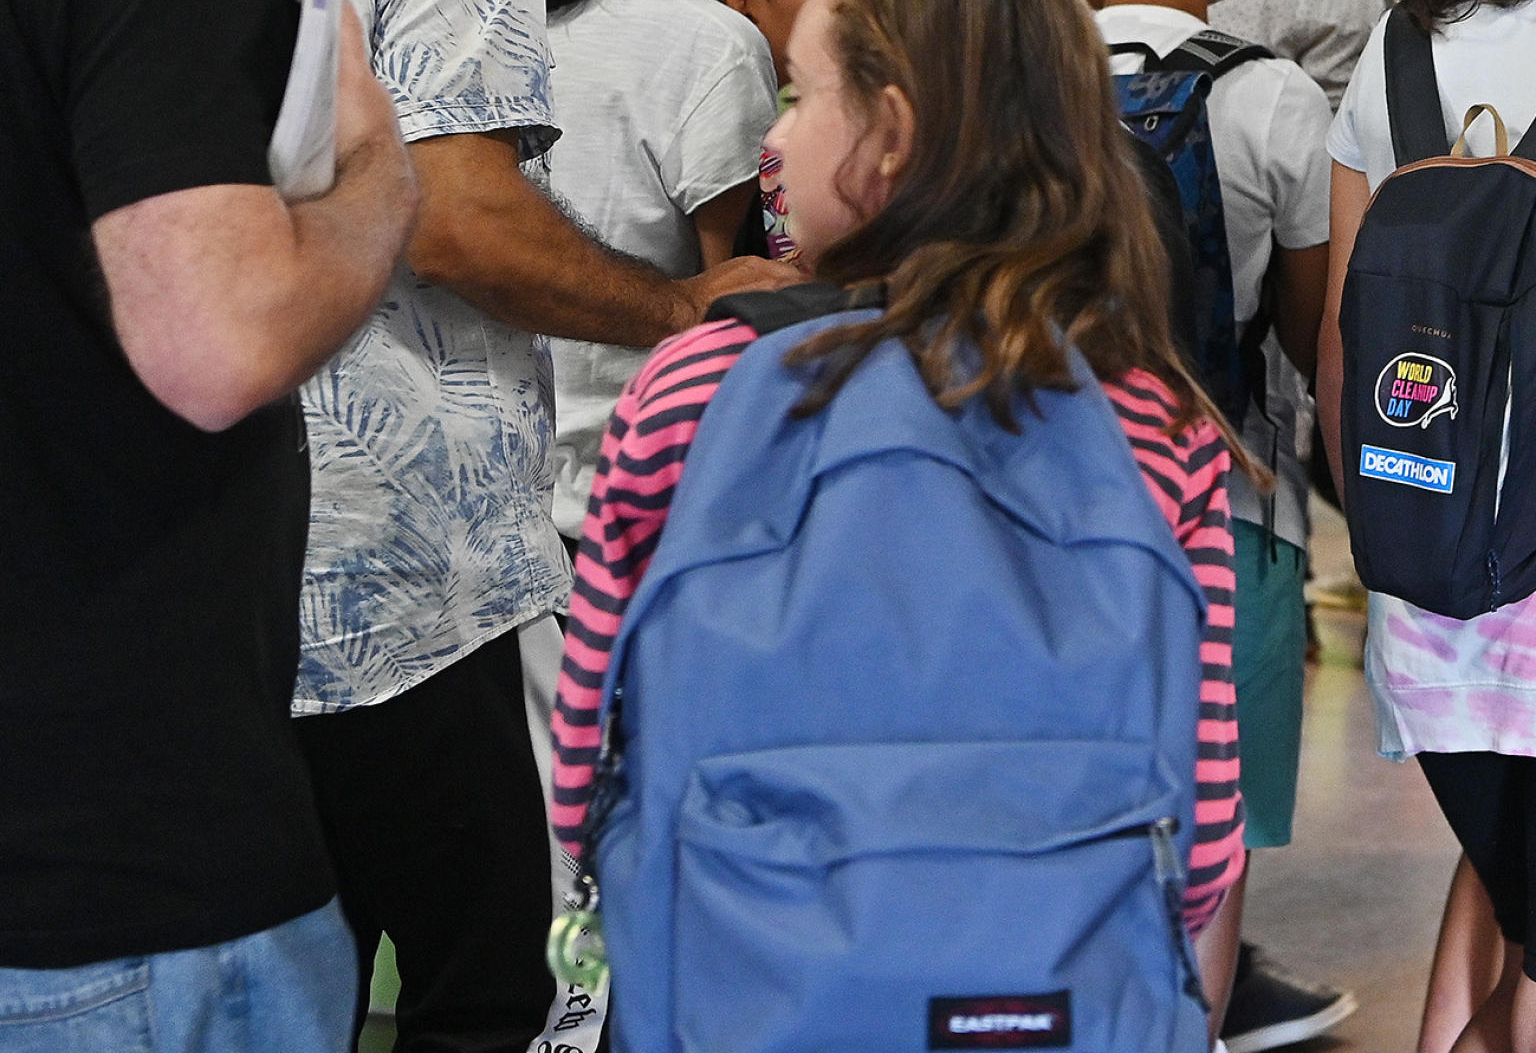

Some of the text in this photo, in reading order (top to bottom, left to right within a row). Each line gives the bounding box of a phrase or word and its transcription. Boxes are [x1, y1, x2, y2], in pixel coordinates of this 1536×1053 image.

[1397, 361, 1433, 383] WORLD
[1391, 379, 1439, 403] CLEANUP
[1386, 398, 1412, 418] DAY
[1364, 451, 1449, 485] DECATHLON
